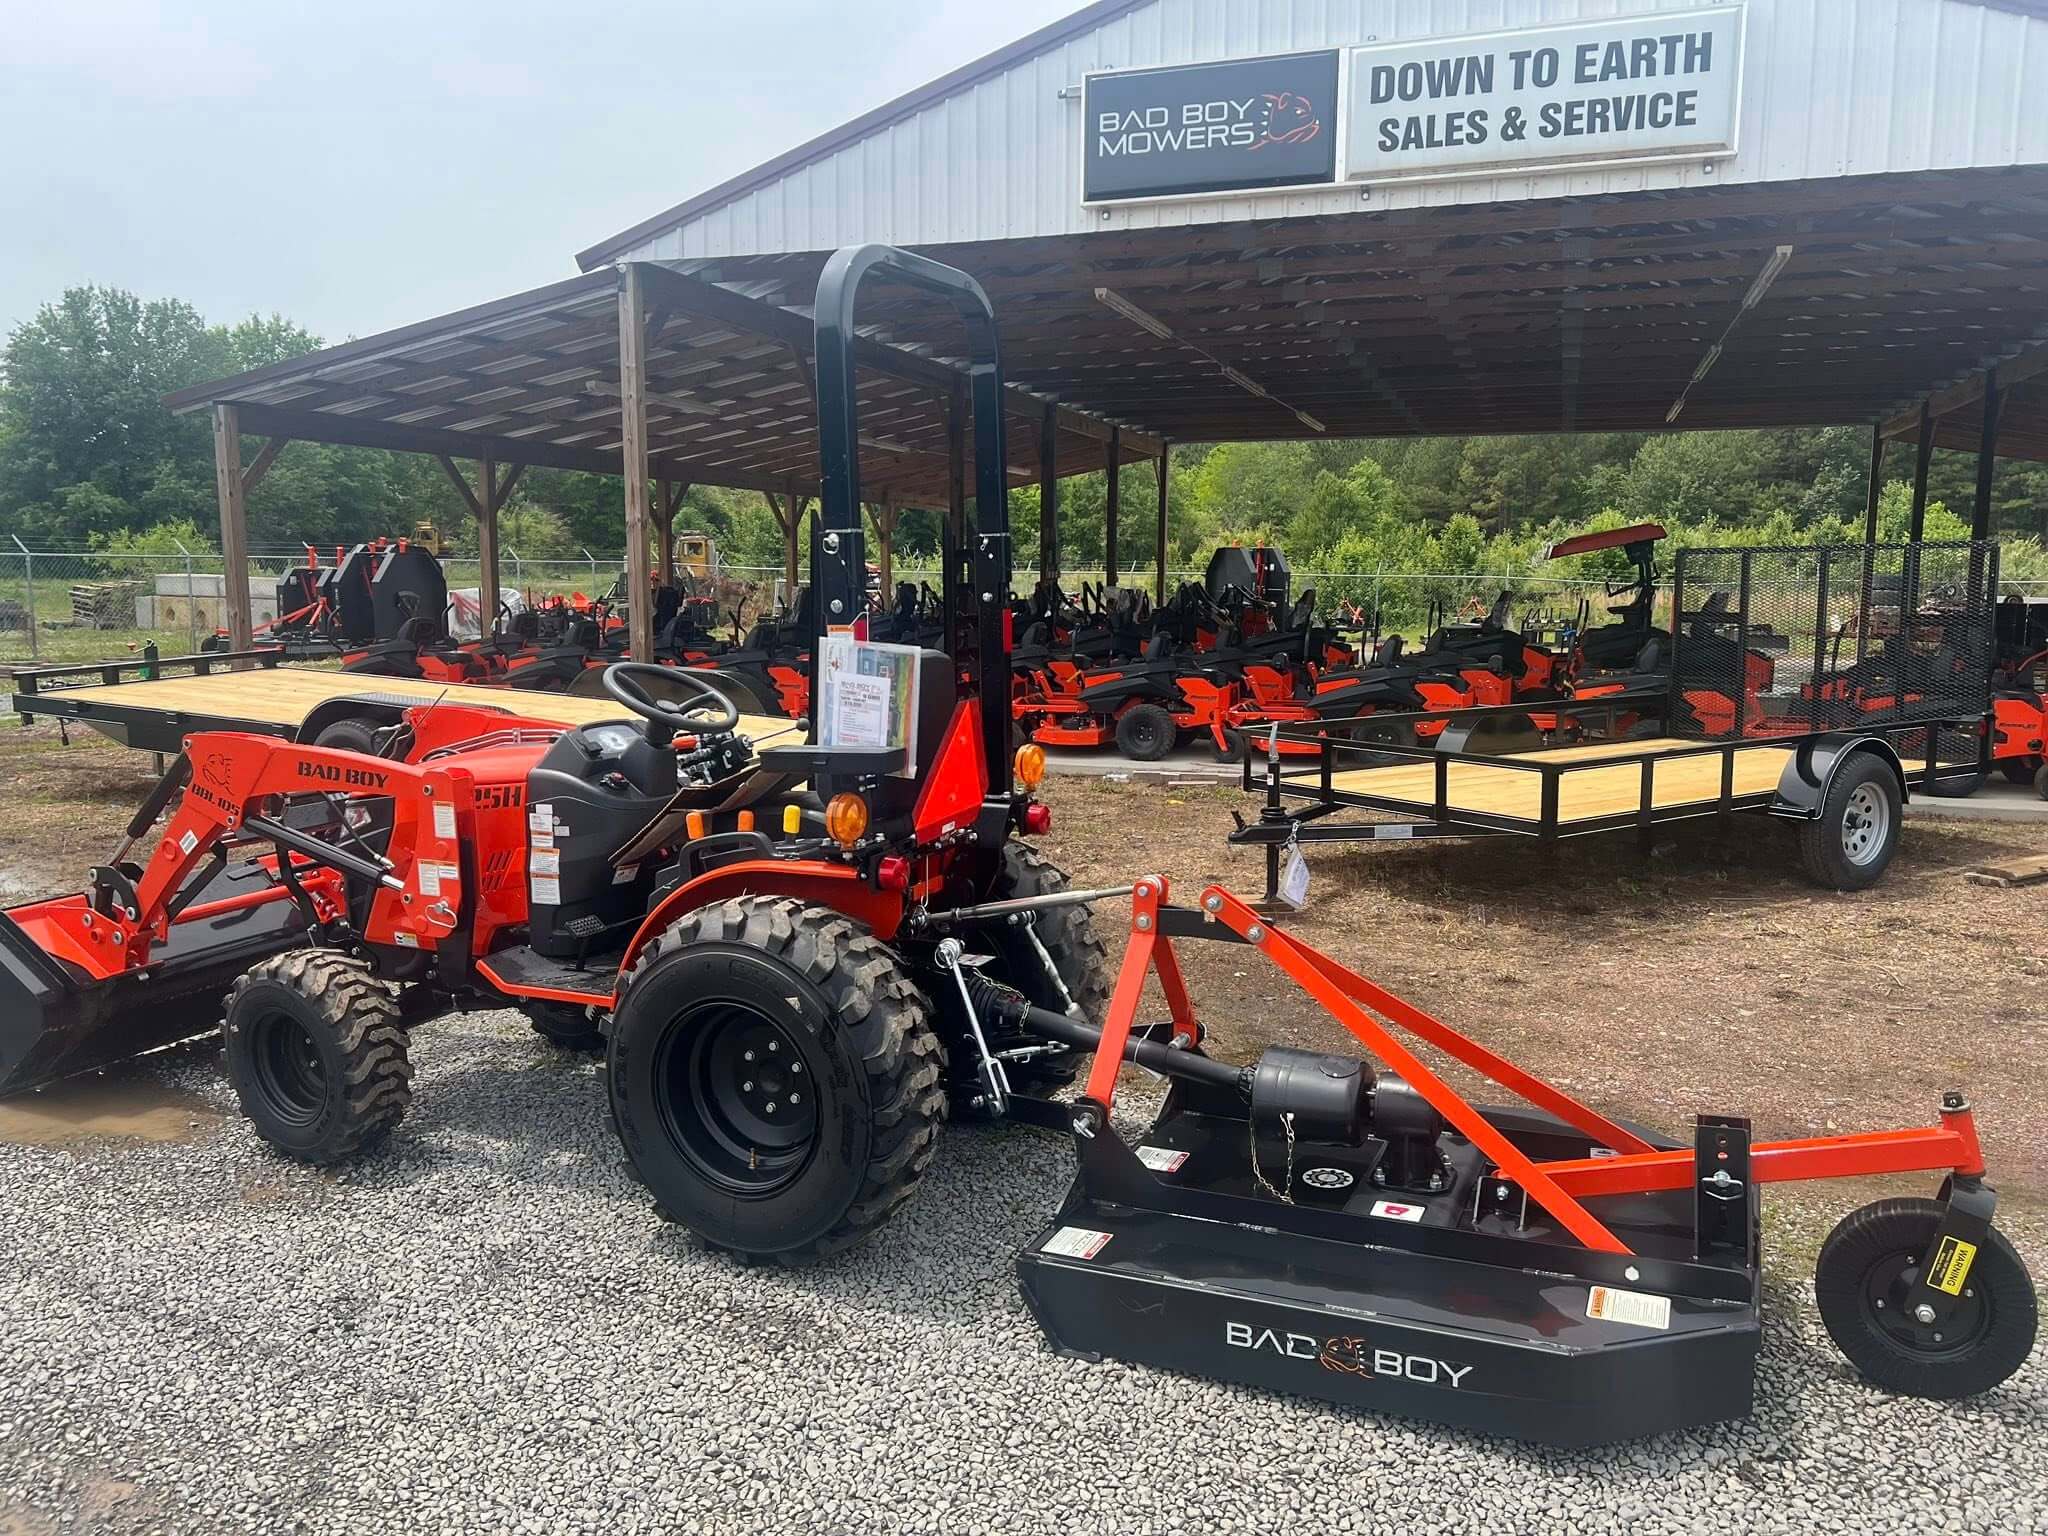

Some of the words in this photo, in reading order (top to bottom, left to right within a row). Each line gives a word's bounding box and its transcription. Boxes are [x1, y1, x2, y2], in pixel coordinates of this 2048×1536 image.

[1370, 54, 1495, 105] DOWN
[1509, 48, 1559, 90] TO
[1574, 31, 1713, 84] EARTH
[1099, 107, 1168, 133] BAD
[1182, 98, 1255, 125] BOY
[1378, 109, 1488, 152] SALES
[1500, 106, 1527, 141] &
[1538, 90, 1698, 138] SERVICE
[1099, 122, 1254, 157] MOWERS
[297, 761, 340, 781] BAD
[345, 768, 389, 788] BOY
[1947, 1249, 1969, 1287] WARNING
[1226, 1321, 1320, 1359] BAD
[1374, 1349, 1474, 1388] BOY
